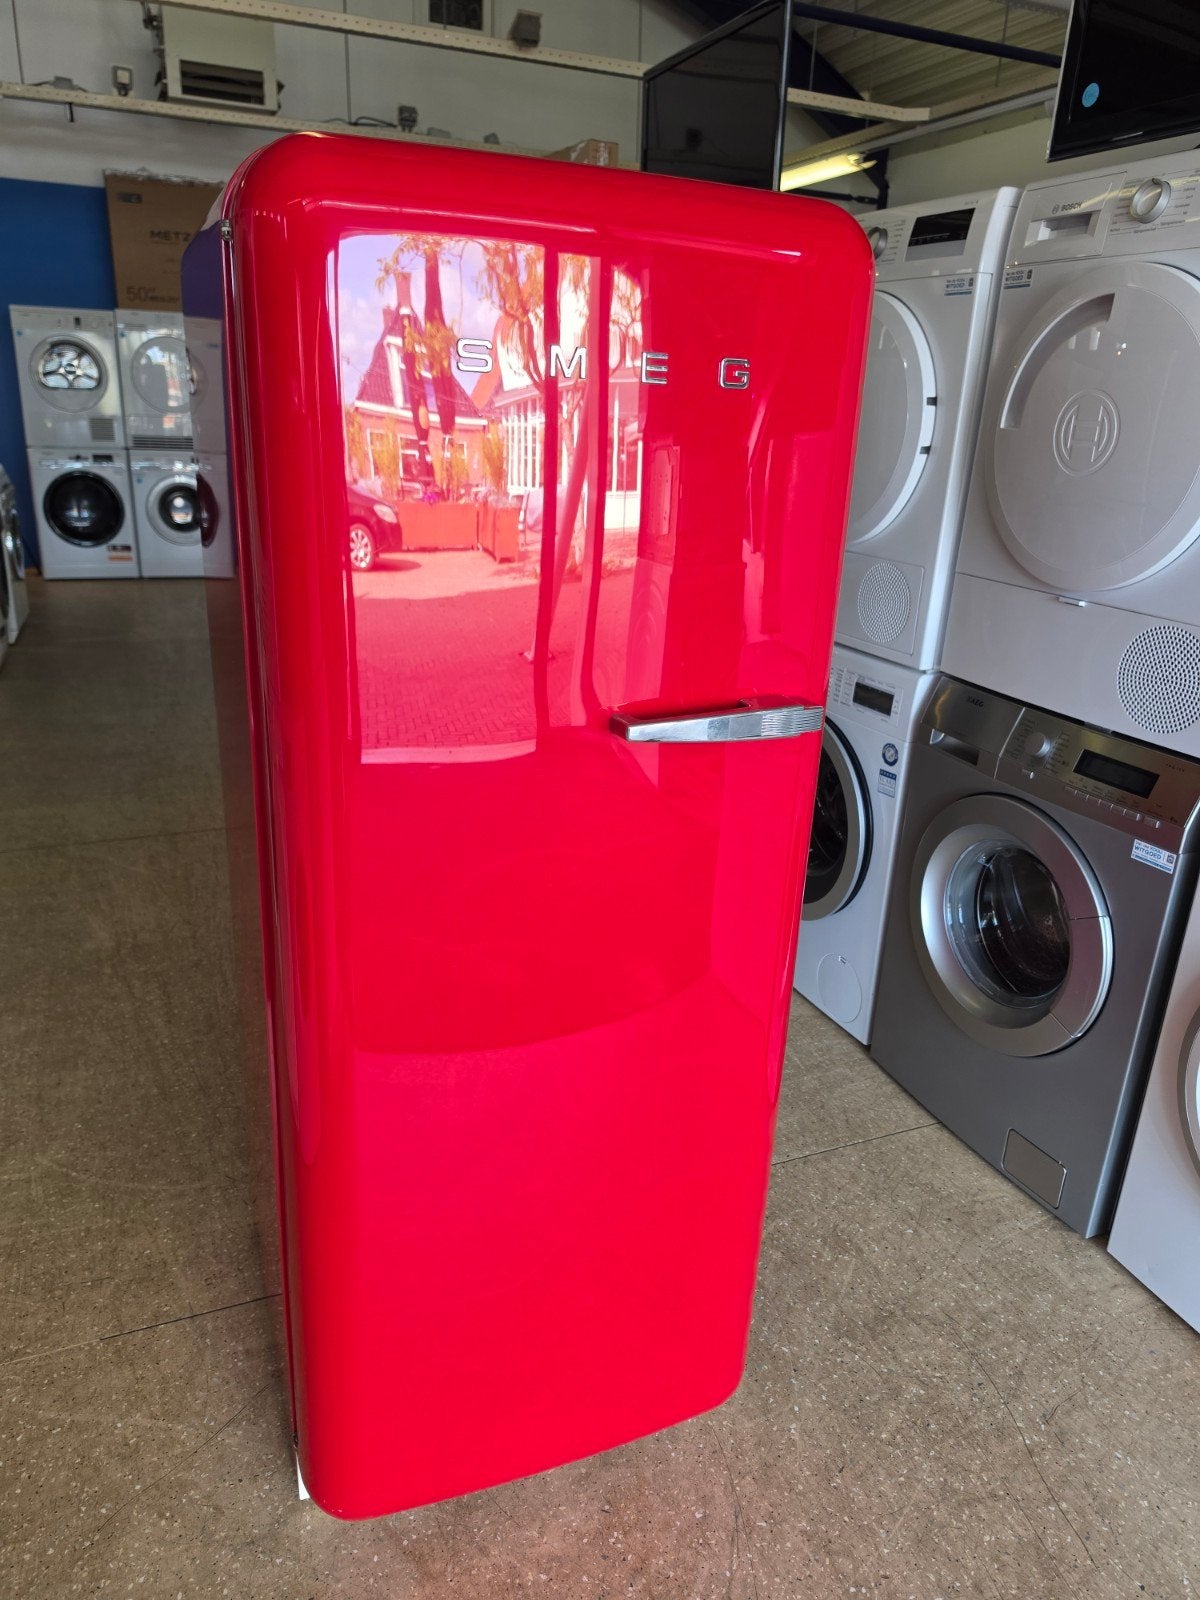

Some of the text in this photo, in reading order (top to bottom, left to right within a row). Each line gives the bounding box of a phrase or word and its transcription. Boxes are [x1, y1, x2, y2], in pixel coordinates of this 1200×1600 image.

[1060, 201, 1082, 212] BOSCH
[150, 230, 191, 242] METZ
[456, 337, 750, 390] SMEG
